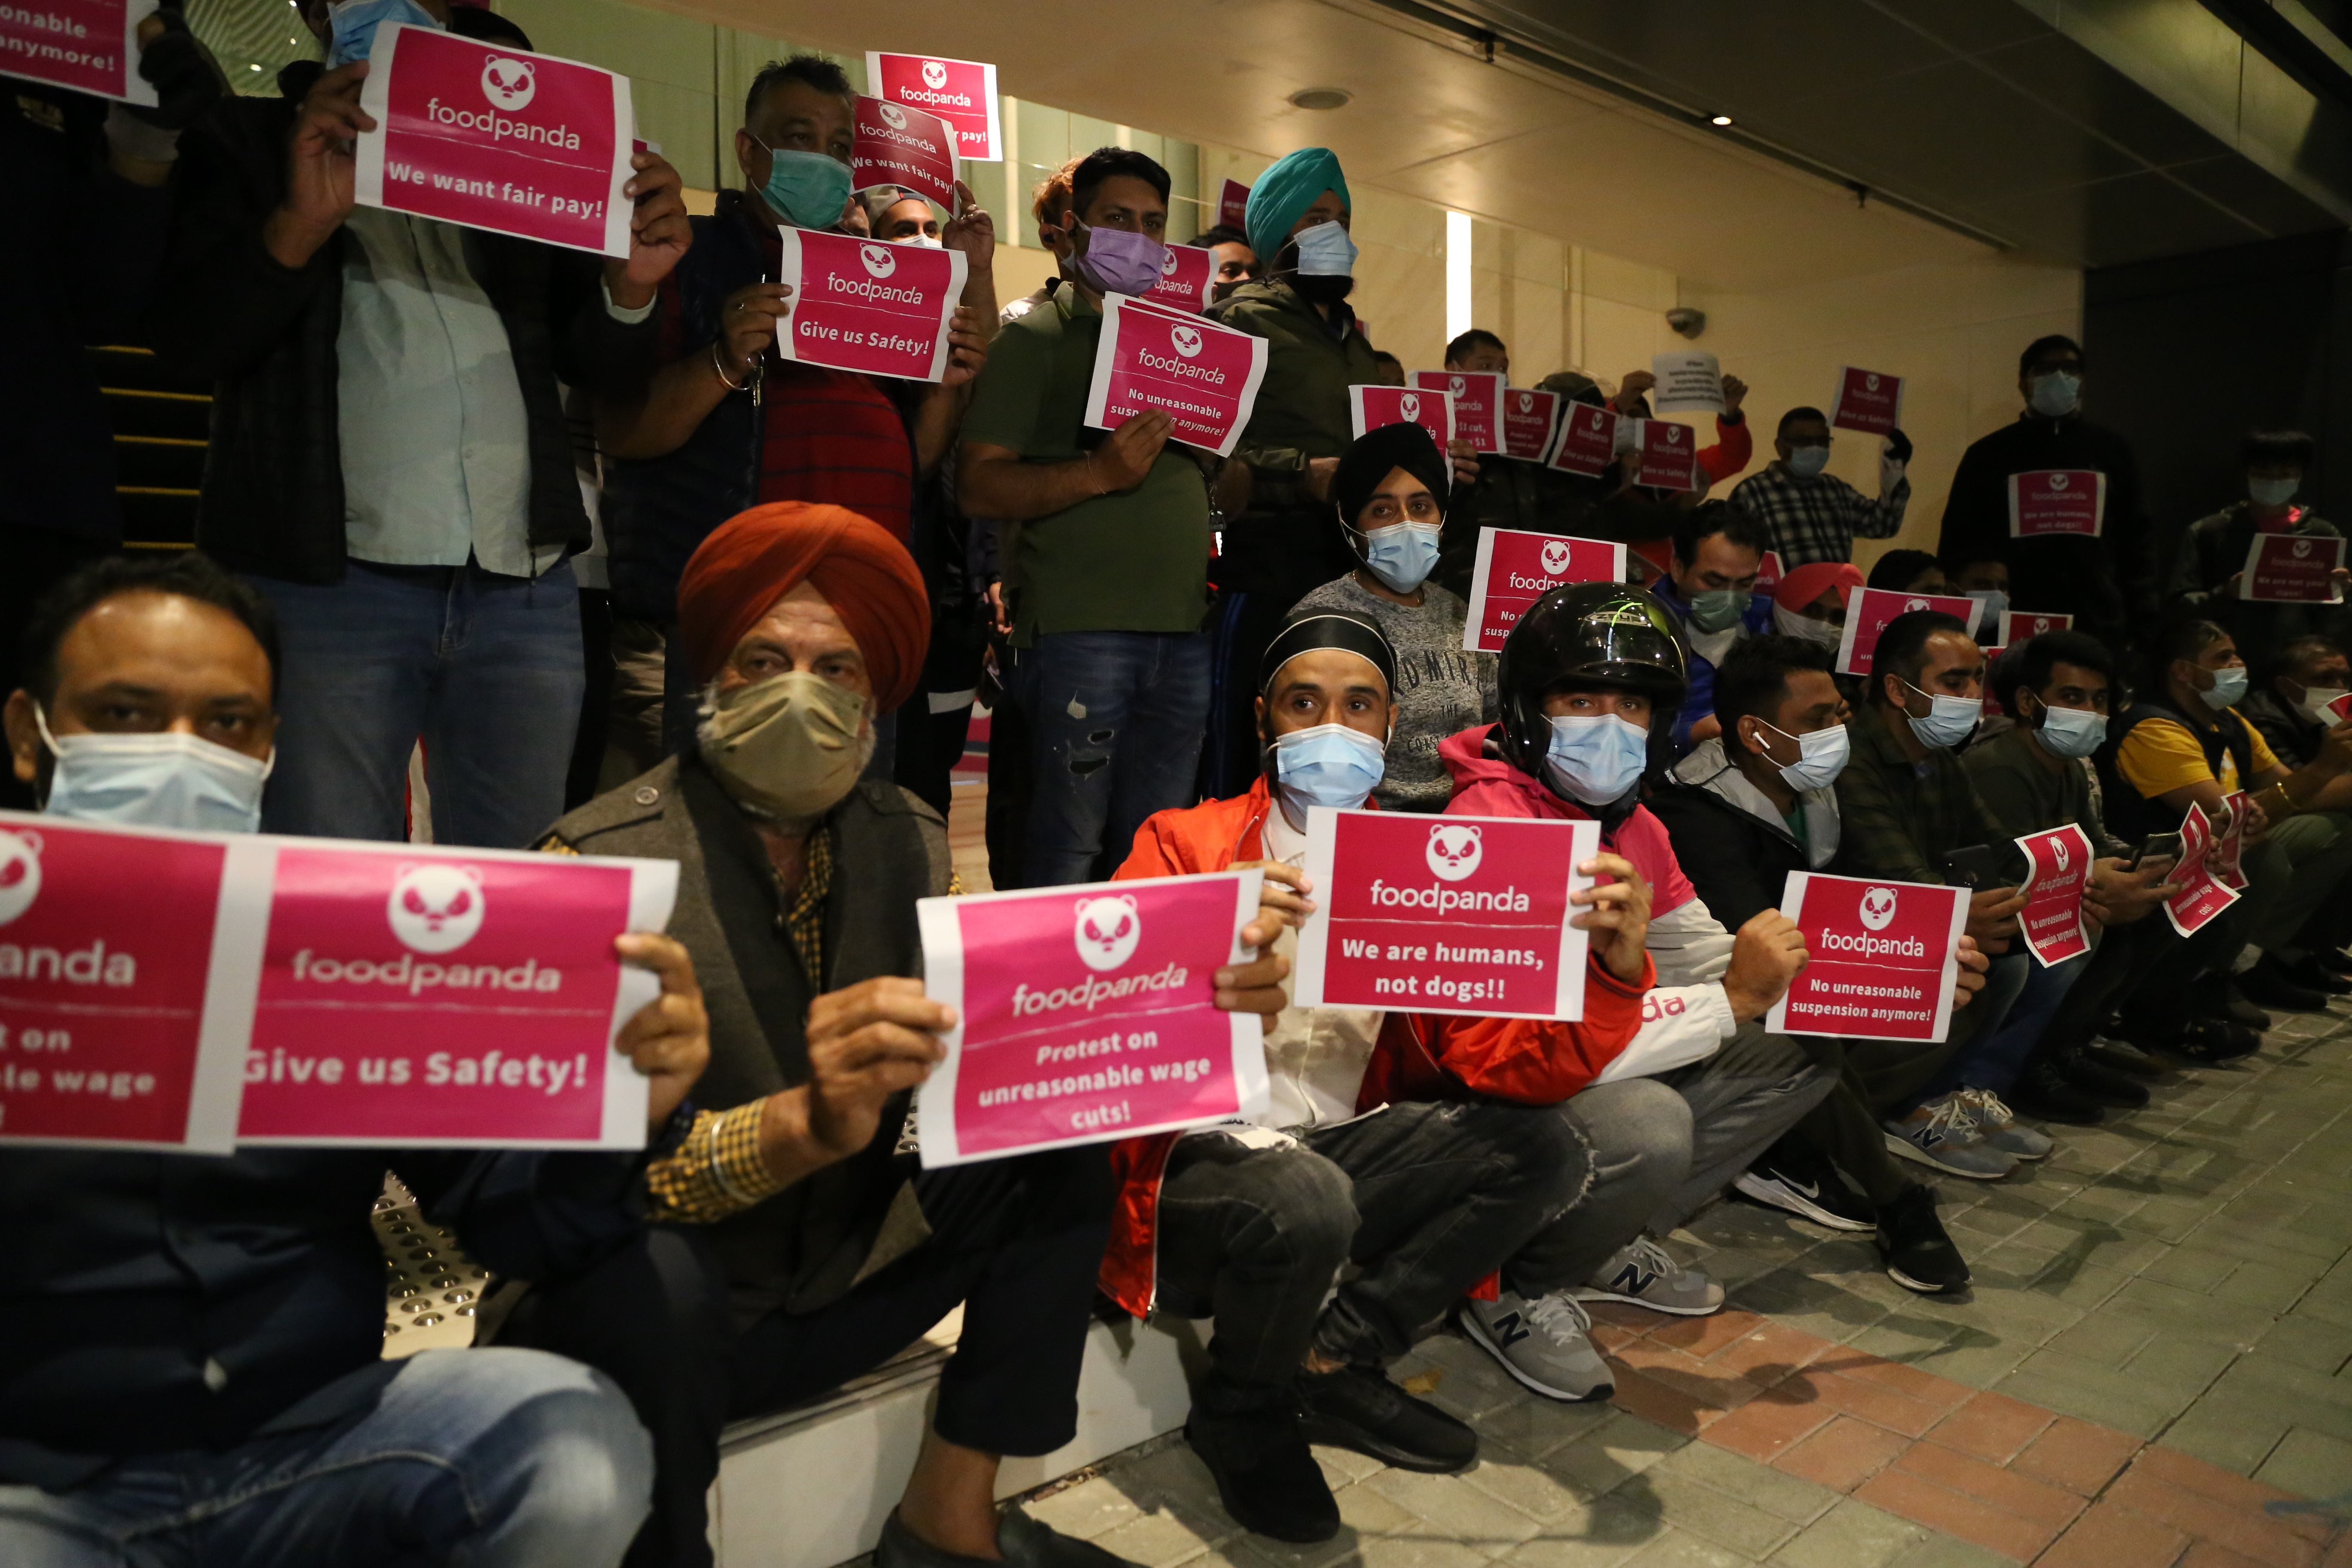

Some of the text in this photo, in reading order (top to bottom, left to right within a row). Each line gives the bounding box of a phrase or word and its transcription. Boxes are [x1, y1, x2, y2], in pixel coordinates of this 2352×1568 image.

[900, 86, 971, 107] foodpanda
[428, 98, 580, 150] foodpanda
[860, 122, 937, 154] foodpanda
[962, 132, 986, 143] pay!
[388, 161, 602, 220] We want fair pay!
[852, 157, 952, 194] We want fair pay!
[828, 272, 922, 306] foodpanda
[1155, 276, 1193, 295] dpanda
[800, 321, 929, 356] Give us Safety!
[1139, 348, 1225, 384] foodpanda
[1129, 389, 1221, 419] No unreasonable
[1455, 400, 1482, 413] panda
[1179, 420, 1225, 436] anymore!
[1501, 611, 1515, 620] No
[2034, 870, 2078, 893] foodpanda
[1370, 879, 1529, 916] foodpanda
[2030, 909, 2072, 930] No unreasonable
[1822, 928, 1924, 958] foodpanda
[2034, 925, 2079, 950] suspension anymore!
[1343, 939, 1543, 971] We are humans,
[294, 949, 562, 996] foodpanda
[1012, 962, 1188, 1018] foodpanda
[1375, 975, 1504, 1002] not dogs!!
[1810, 979, 1921, 999] No unreasonable
[1792, 1000, 1930, 1021] suspension anymore!
[21, 1029, 70, 1051] on
[1036, 1031, 1158, 1065] Protest on
[54, 1072, 155, 1099] wage
[242, 1048, 587, 1095] Give us Safety!
[979, 1059, 1210, 1107] unreasonable wage
[1070, 1100, 1130, 1129] cuts!
